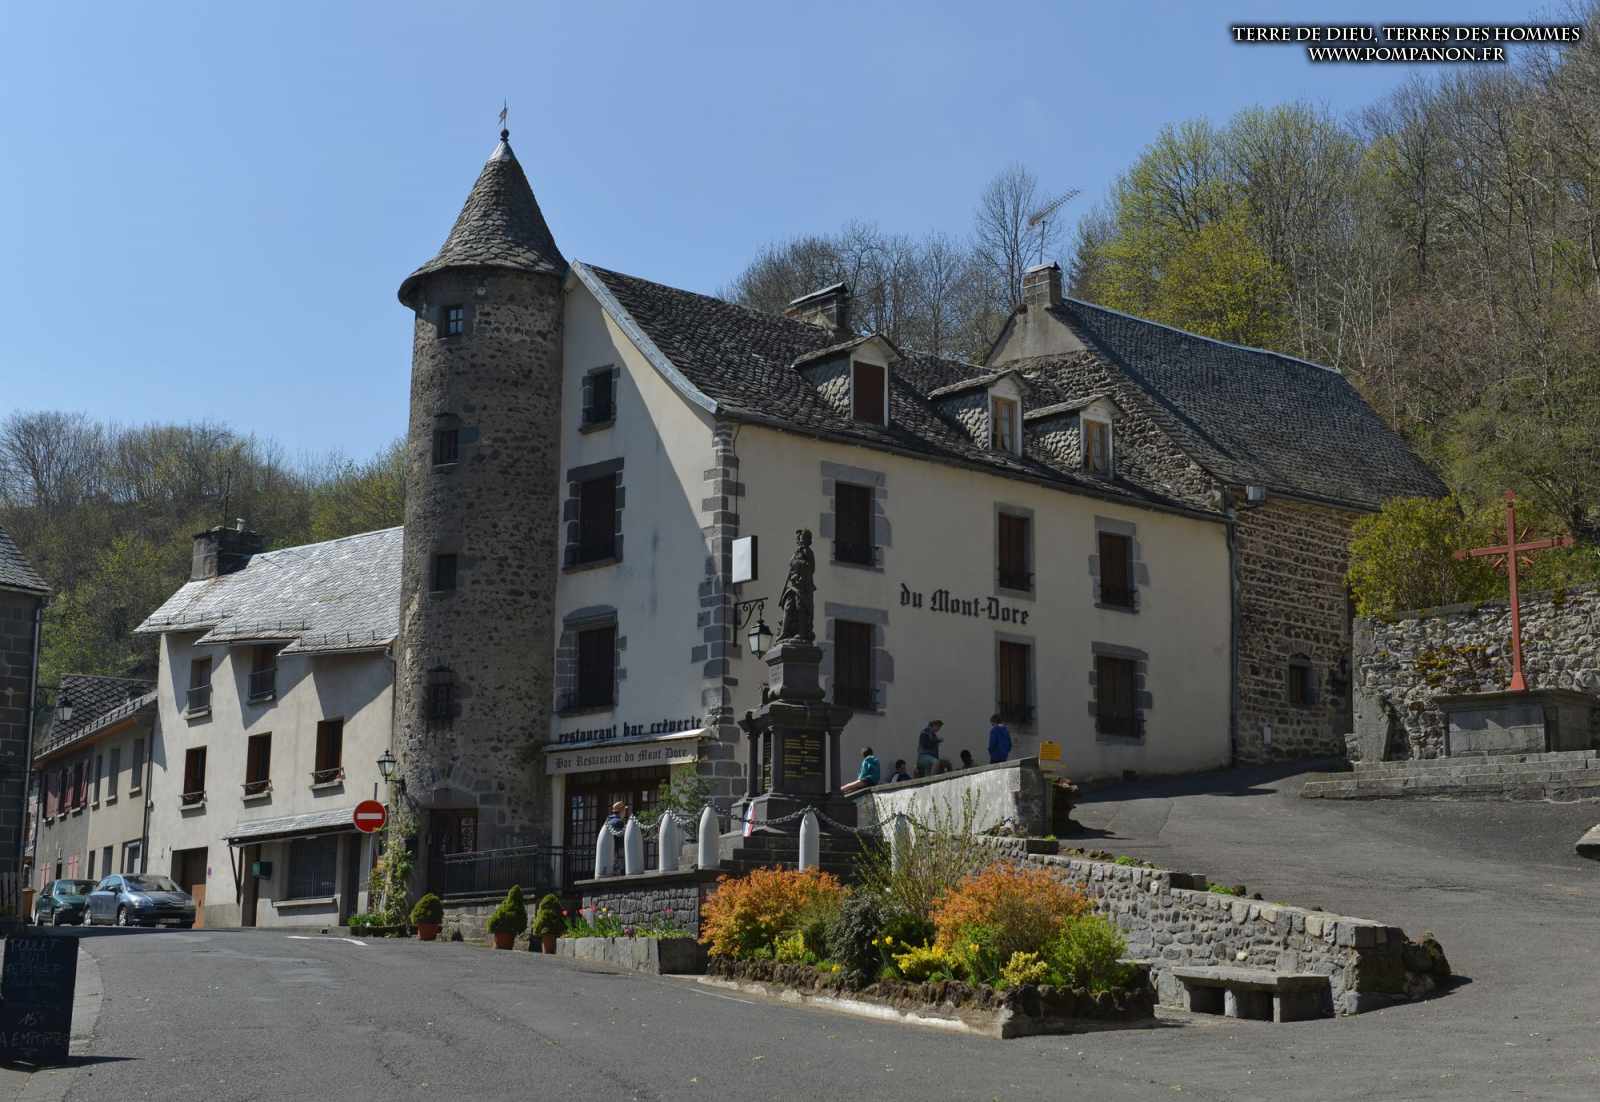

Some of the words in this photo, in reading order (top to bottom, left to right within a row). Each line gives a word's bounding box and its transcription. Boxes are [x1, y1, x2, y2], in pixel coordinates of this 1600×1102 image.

[900, 583, 922, 608] du
[930, 589, 1029, 625] Mont-Dore
[558, 724, 617, 745] restaurant
[623, 721, 644, 738] bar
